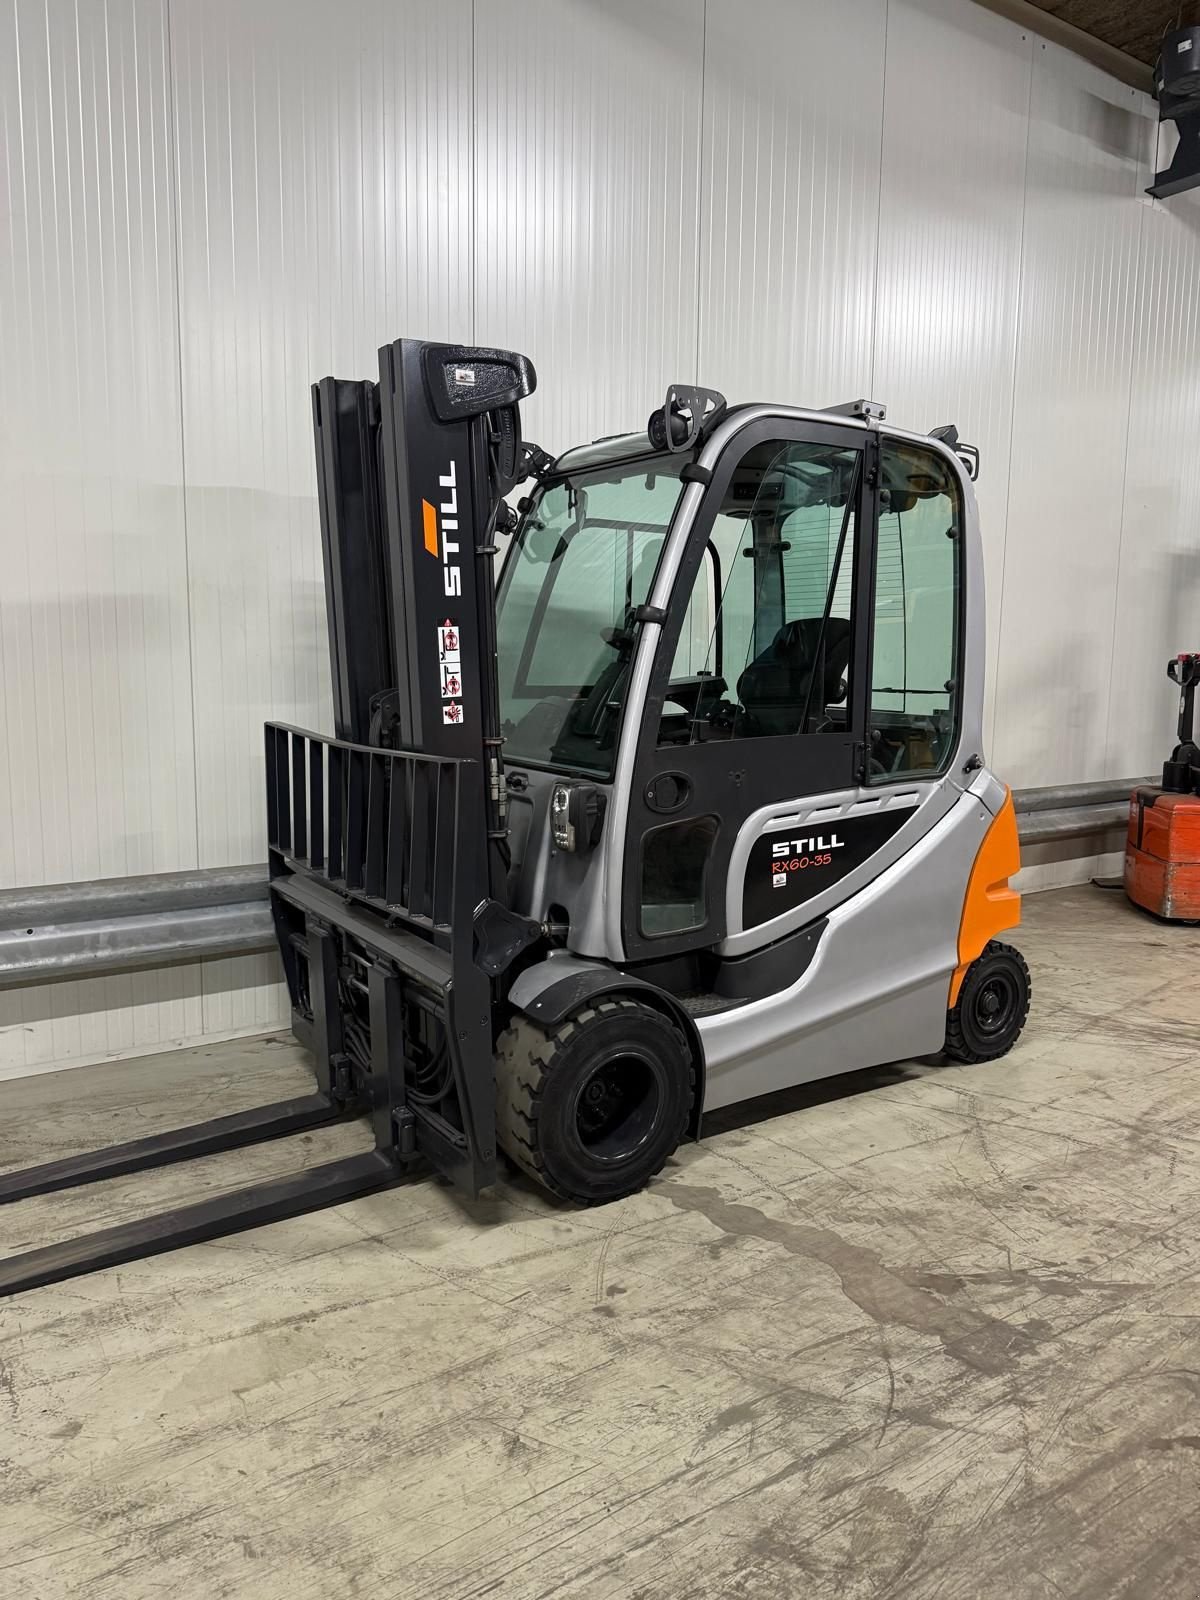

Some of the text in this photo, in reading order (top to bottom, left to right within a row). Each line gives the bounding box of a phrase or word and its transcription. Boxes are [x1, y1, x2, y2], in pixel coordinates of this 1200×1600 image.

[439, 460, 462, 597] STILL
[772, 834, 845, 858] STILL
[771, 853, 832, 873] RX60-35
